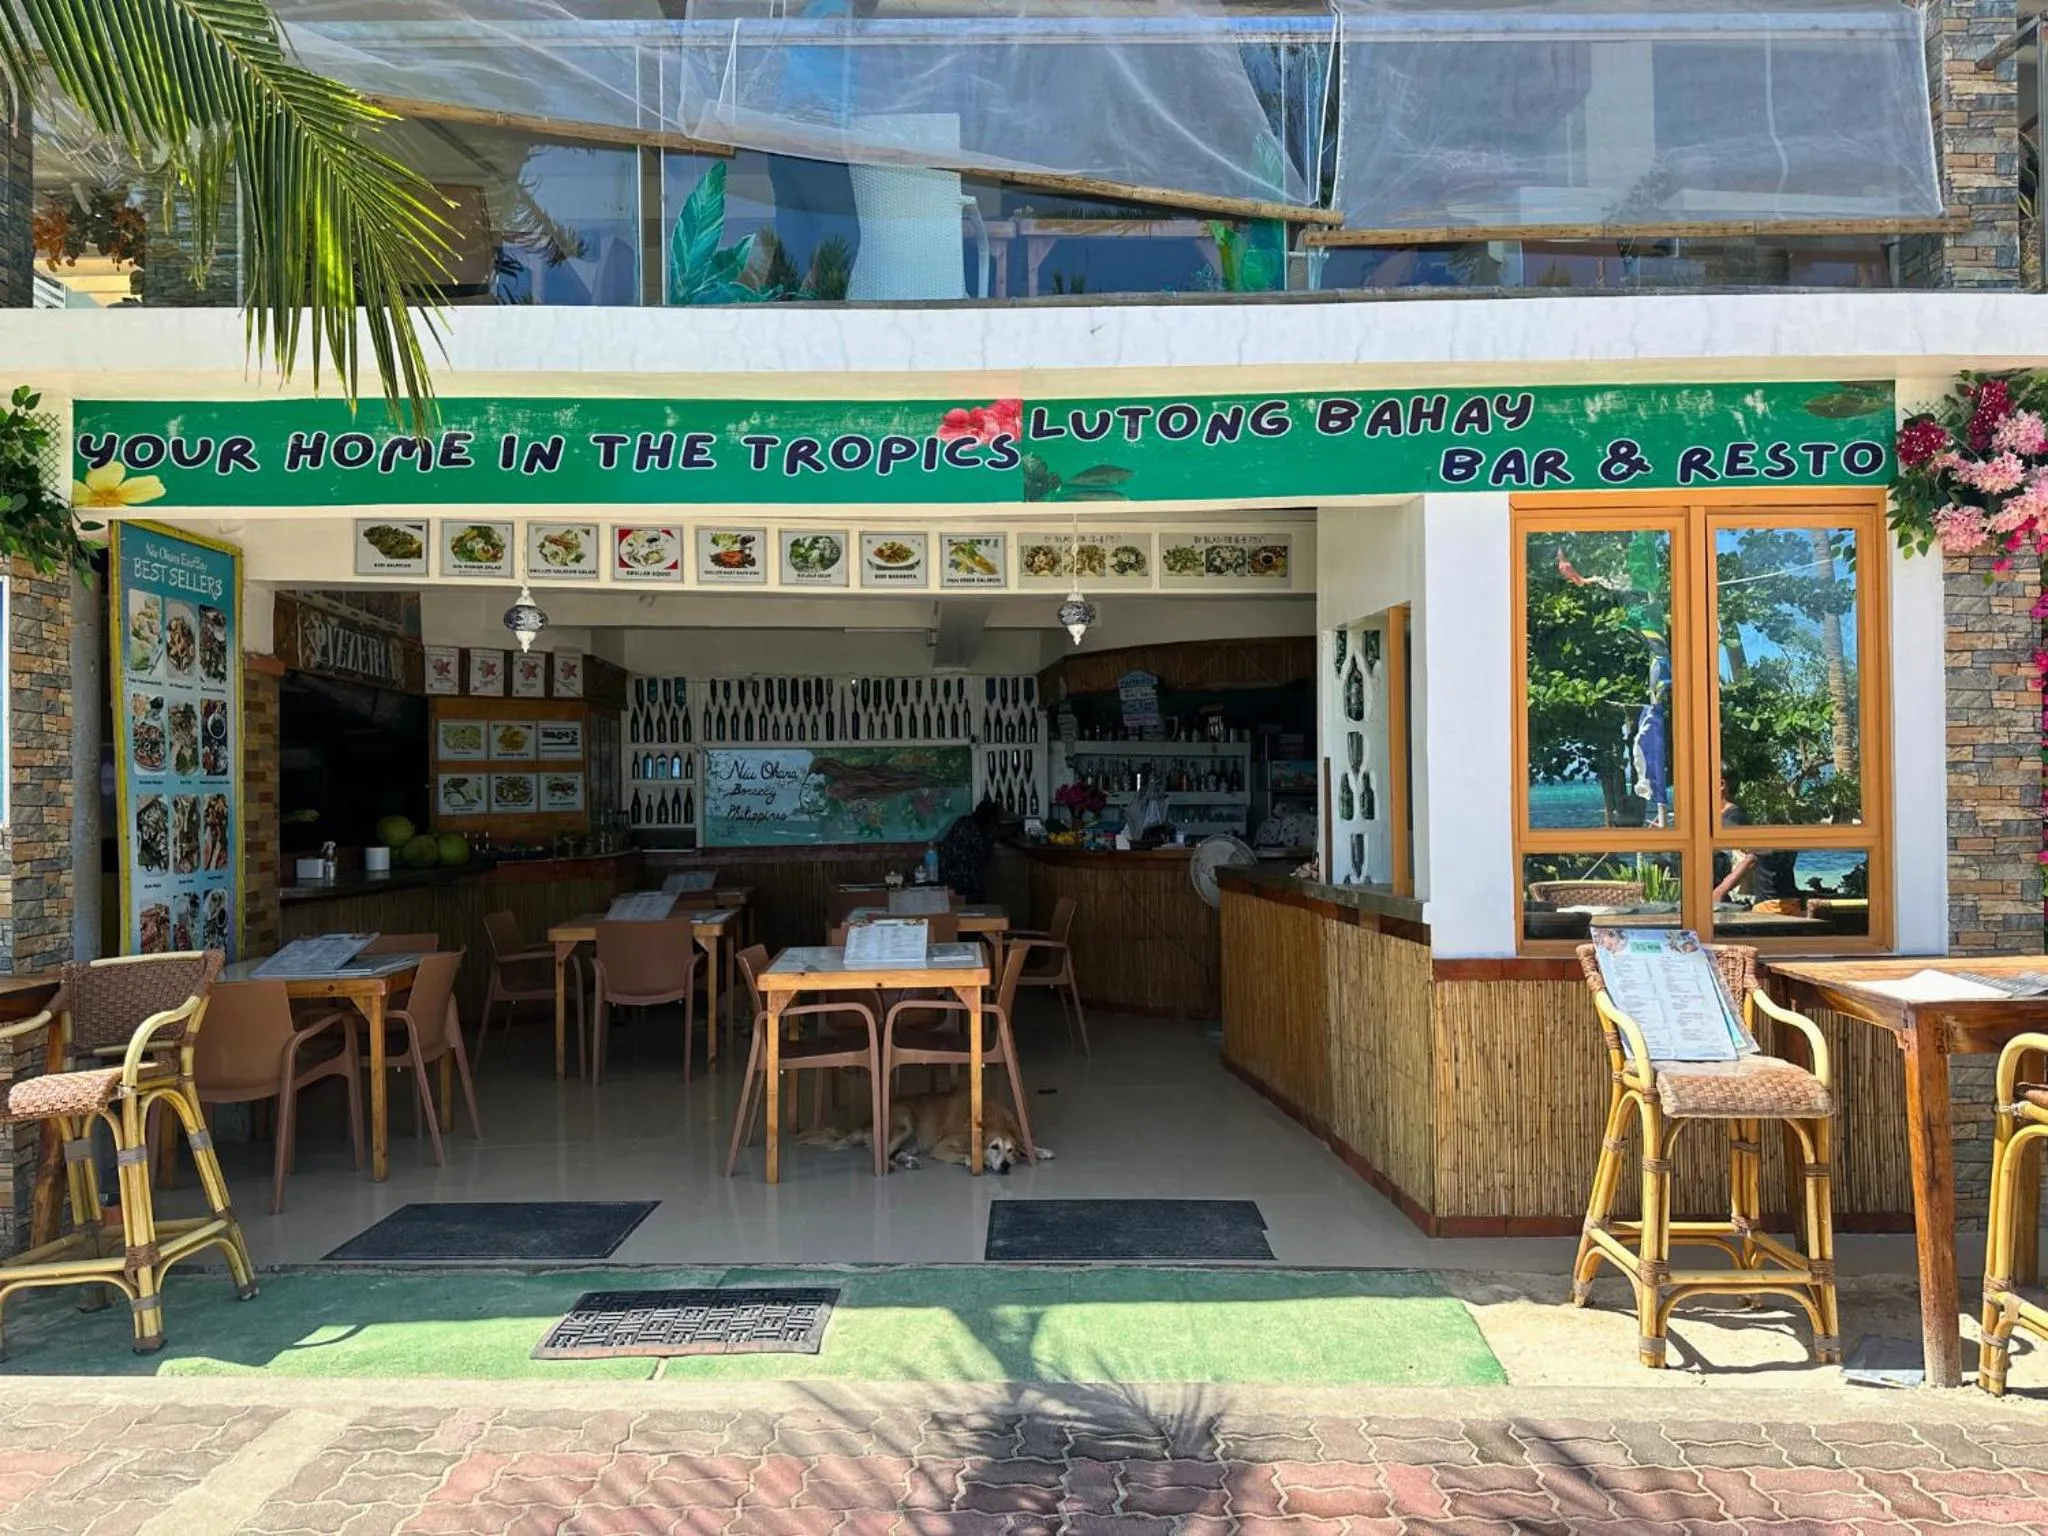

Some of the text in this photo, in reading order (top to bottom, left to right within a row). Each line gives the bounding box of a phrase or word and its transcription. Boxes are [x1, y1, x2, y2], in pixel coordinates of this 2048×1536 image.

[1028, 392, 1535, 446] LUTONG BAHAY
[77, 430, 1023, 477] YOUR HOME IN THE TROPICS
[1439, 437, 1887, 487] BAR & RESTO
[133, 557, 224, 601] BEST SELLERS
[314, 620, 397, 680] PIZZERIA
[760, 760, 799, 781] Ohana
